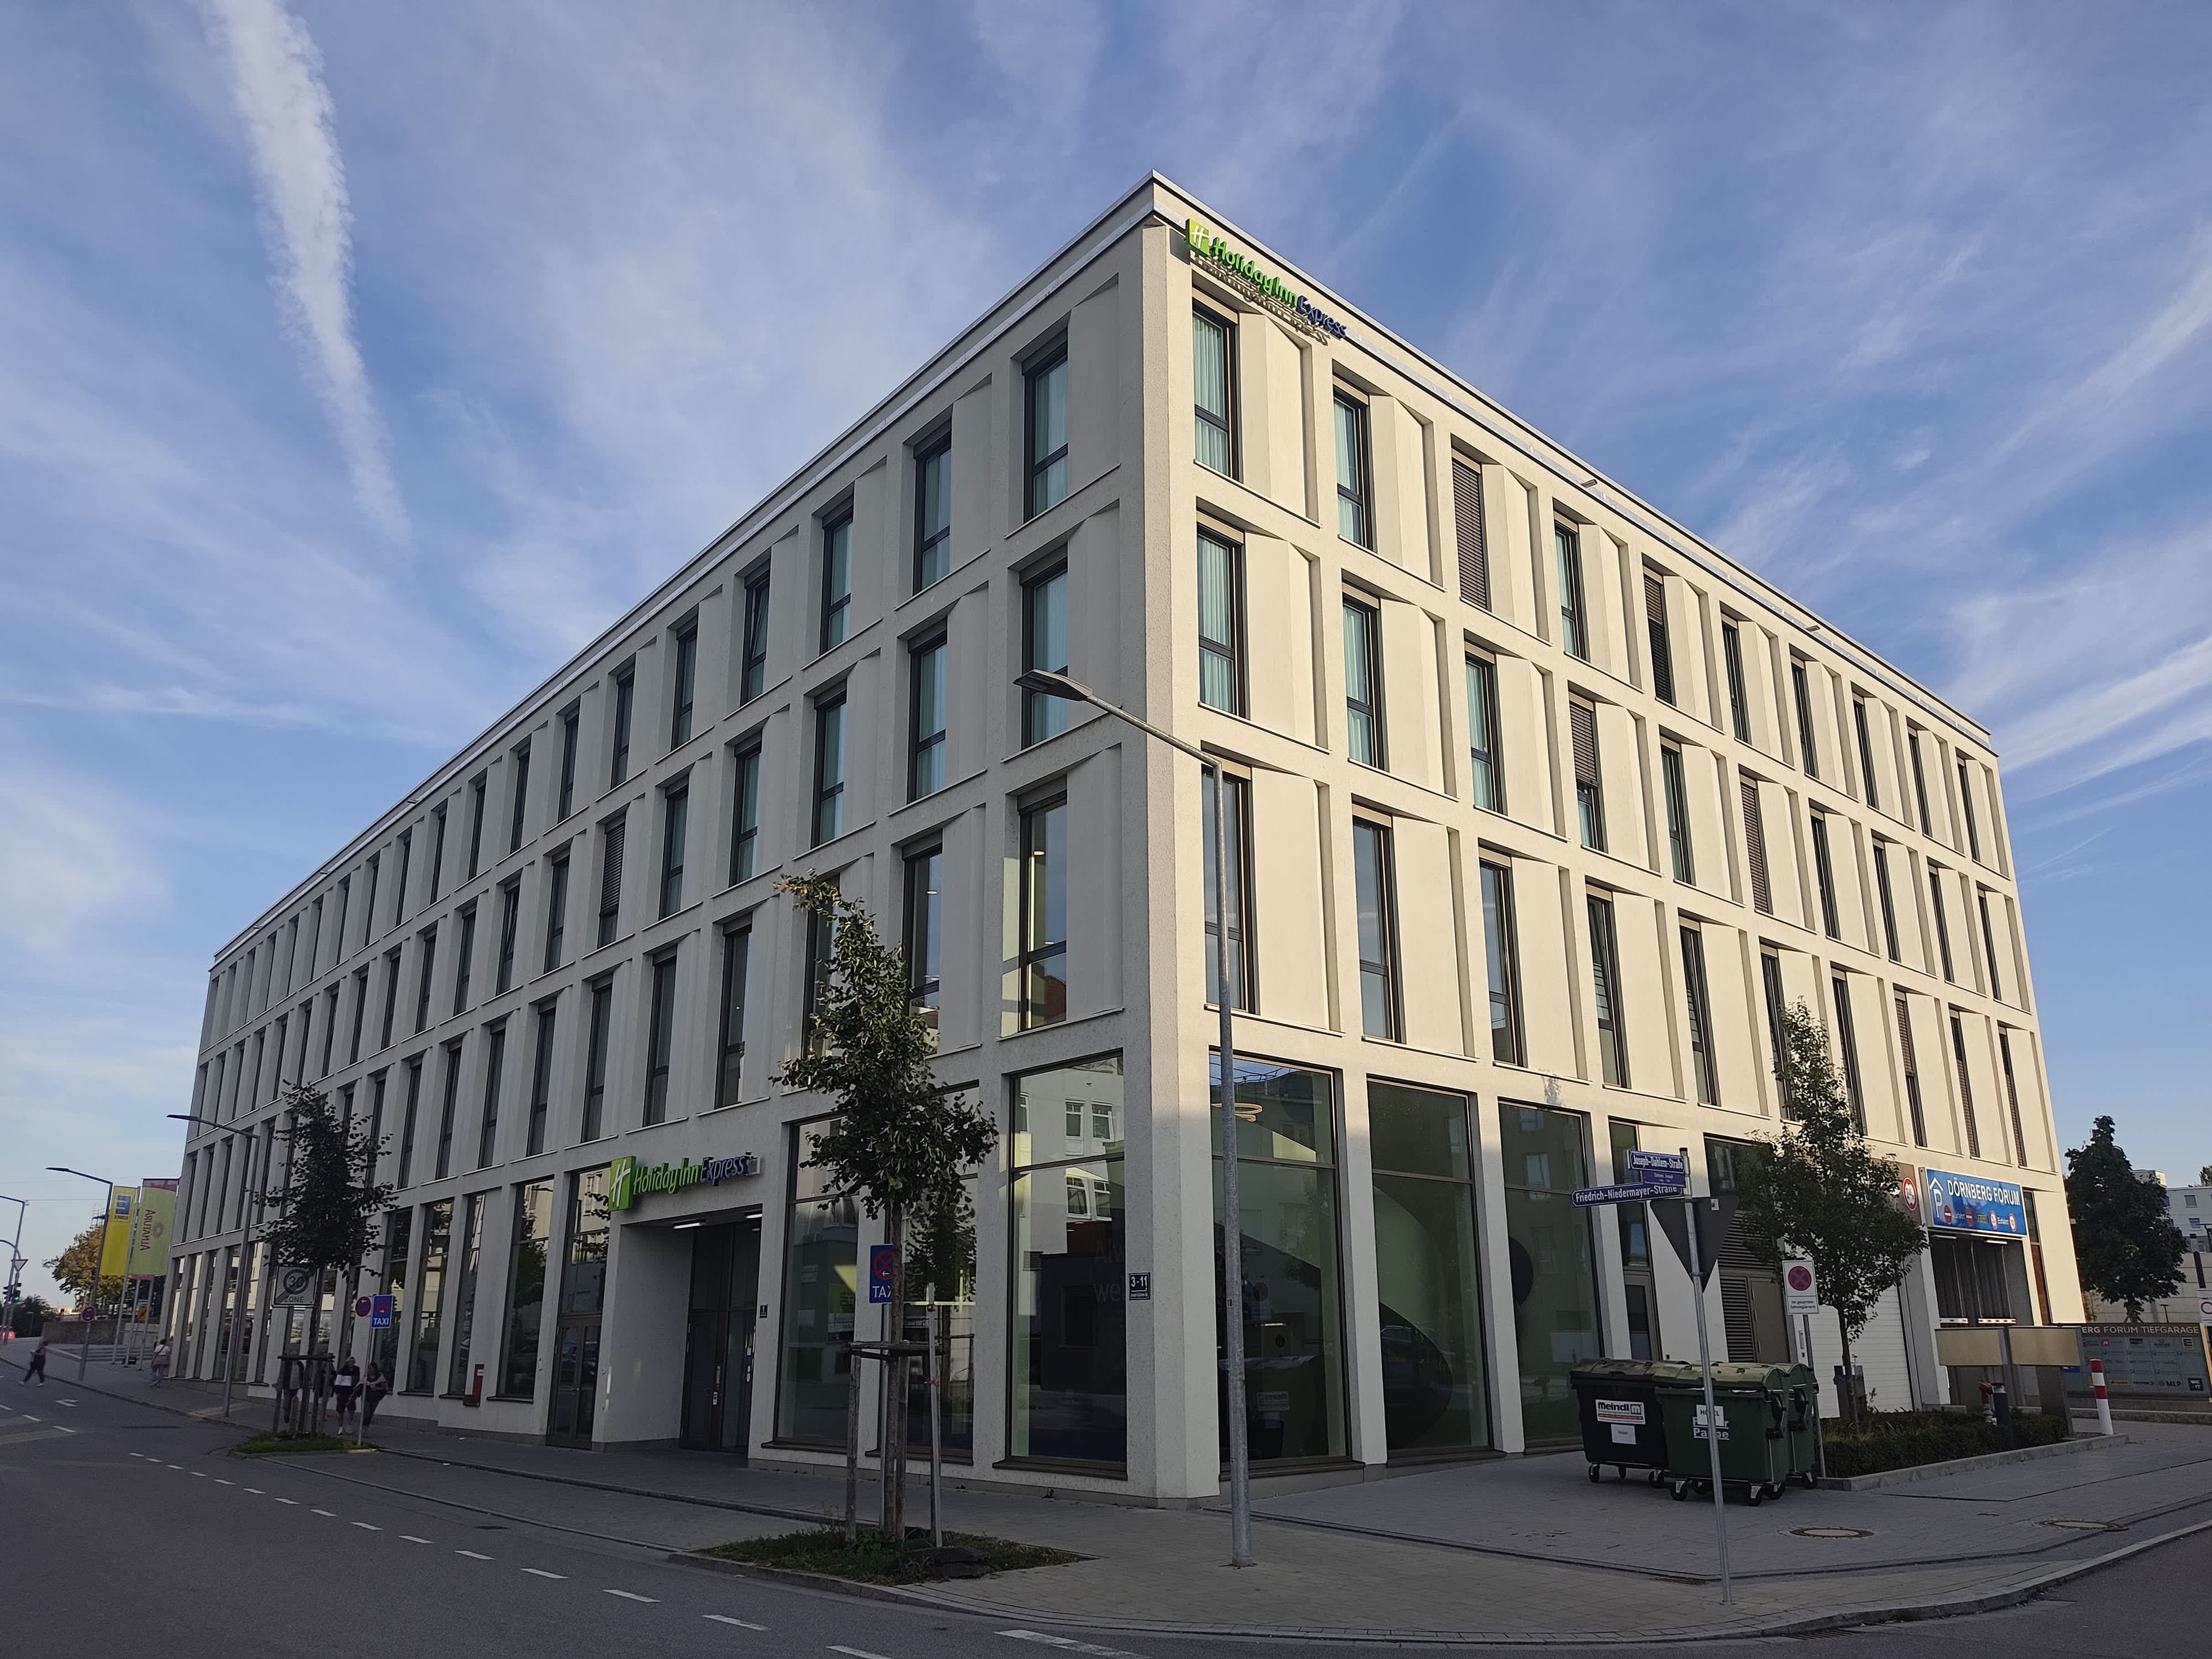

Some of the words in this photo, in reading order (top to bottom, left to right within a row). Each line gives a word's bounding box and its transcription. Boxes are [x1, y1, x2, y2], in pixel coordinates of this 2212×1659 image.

[1297, 295, 1347, 340] Express
[700, 1156, 748, 1186] Express
[1946, 1177, 1993, 1202] DÖRNBERG
[1994, 1187, 2020, 1206] FORUM
[1131, 1275, 1147, 1287] 3-11
[373, 1317, 389, 1325] TAXI
[2103, 1326, 2139, 1334] FORUM
[2140, 1326, 2199, 1334] TIEFGARAGE
[1693, 1427, 1729, 1438] Pape
